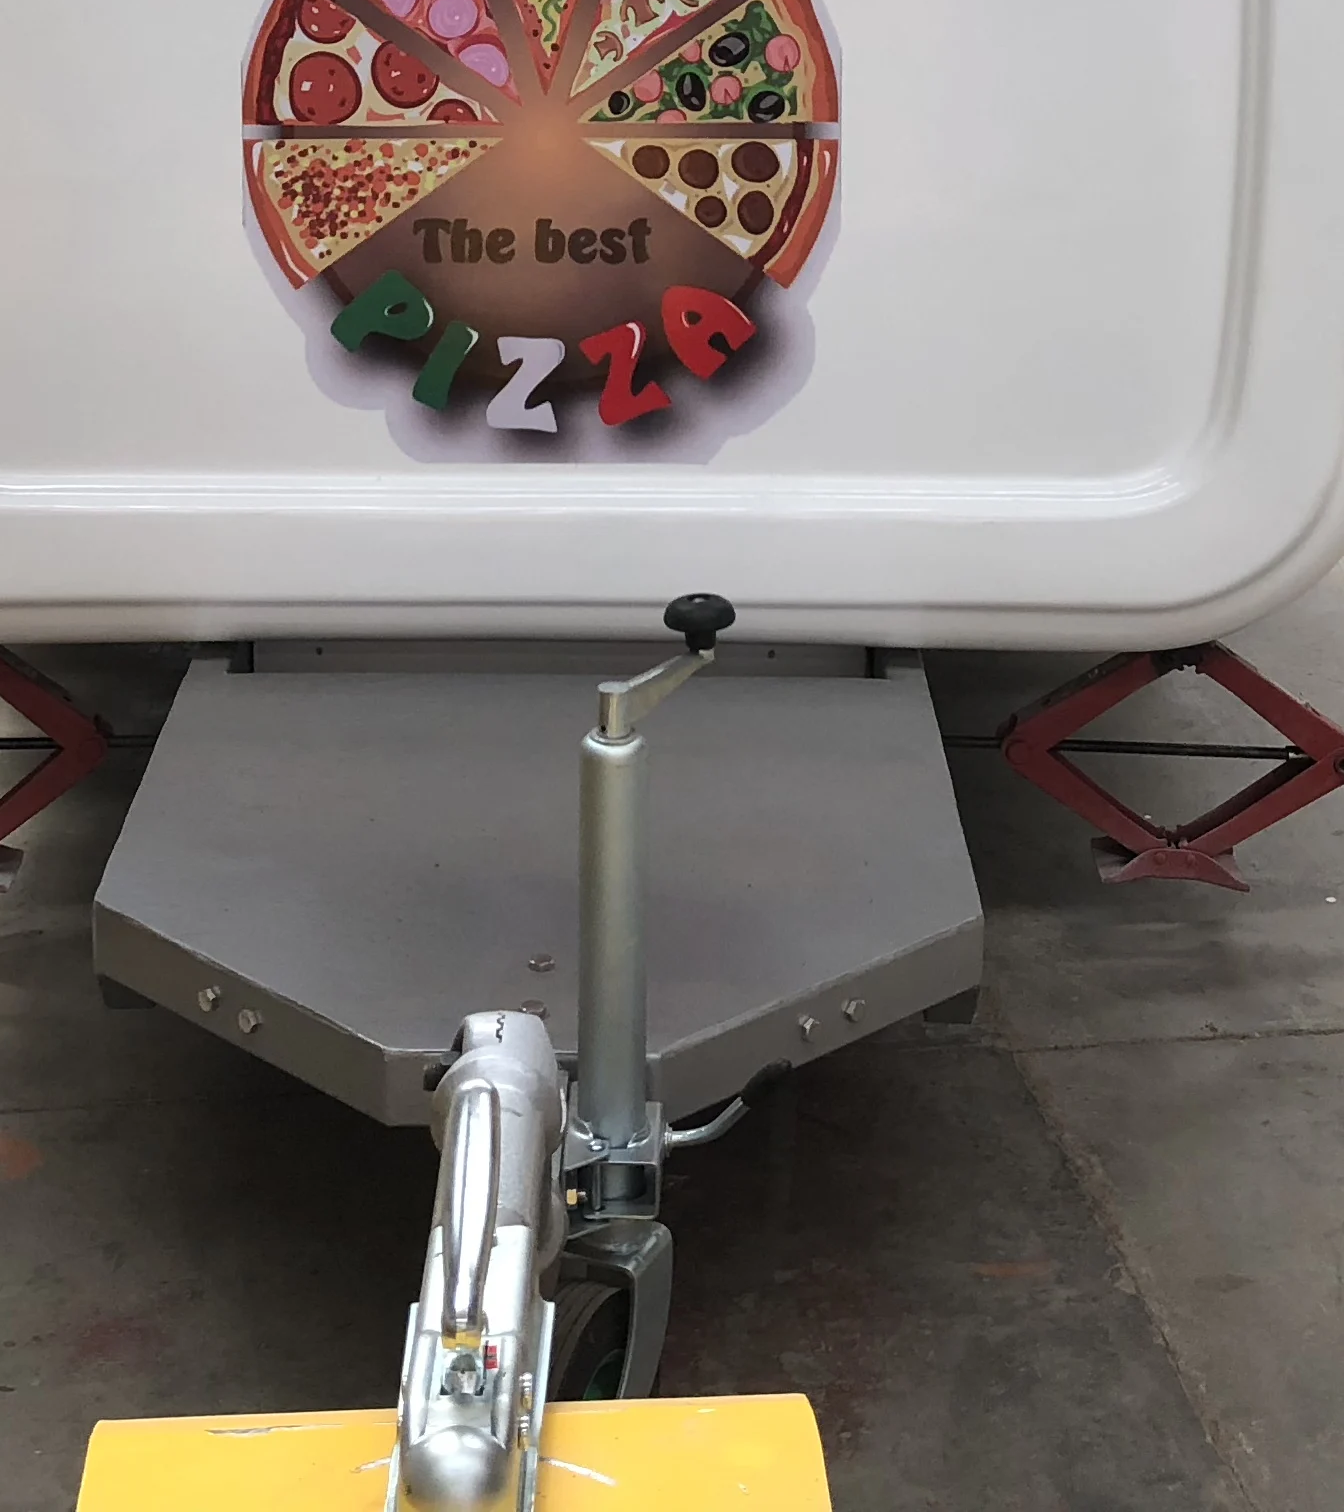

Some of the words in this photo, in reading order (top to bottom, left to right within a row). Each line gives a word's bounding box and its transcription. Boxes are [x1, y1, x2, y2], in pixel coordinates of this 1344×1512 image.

[413, 218, 516, 265] The
[535, 218, 652, 265] best
[330, 271, 756, 433] PIZZA
